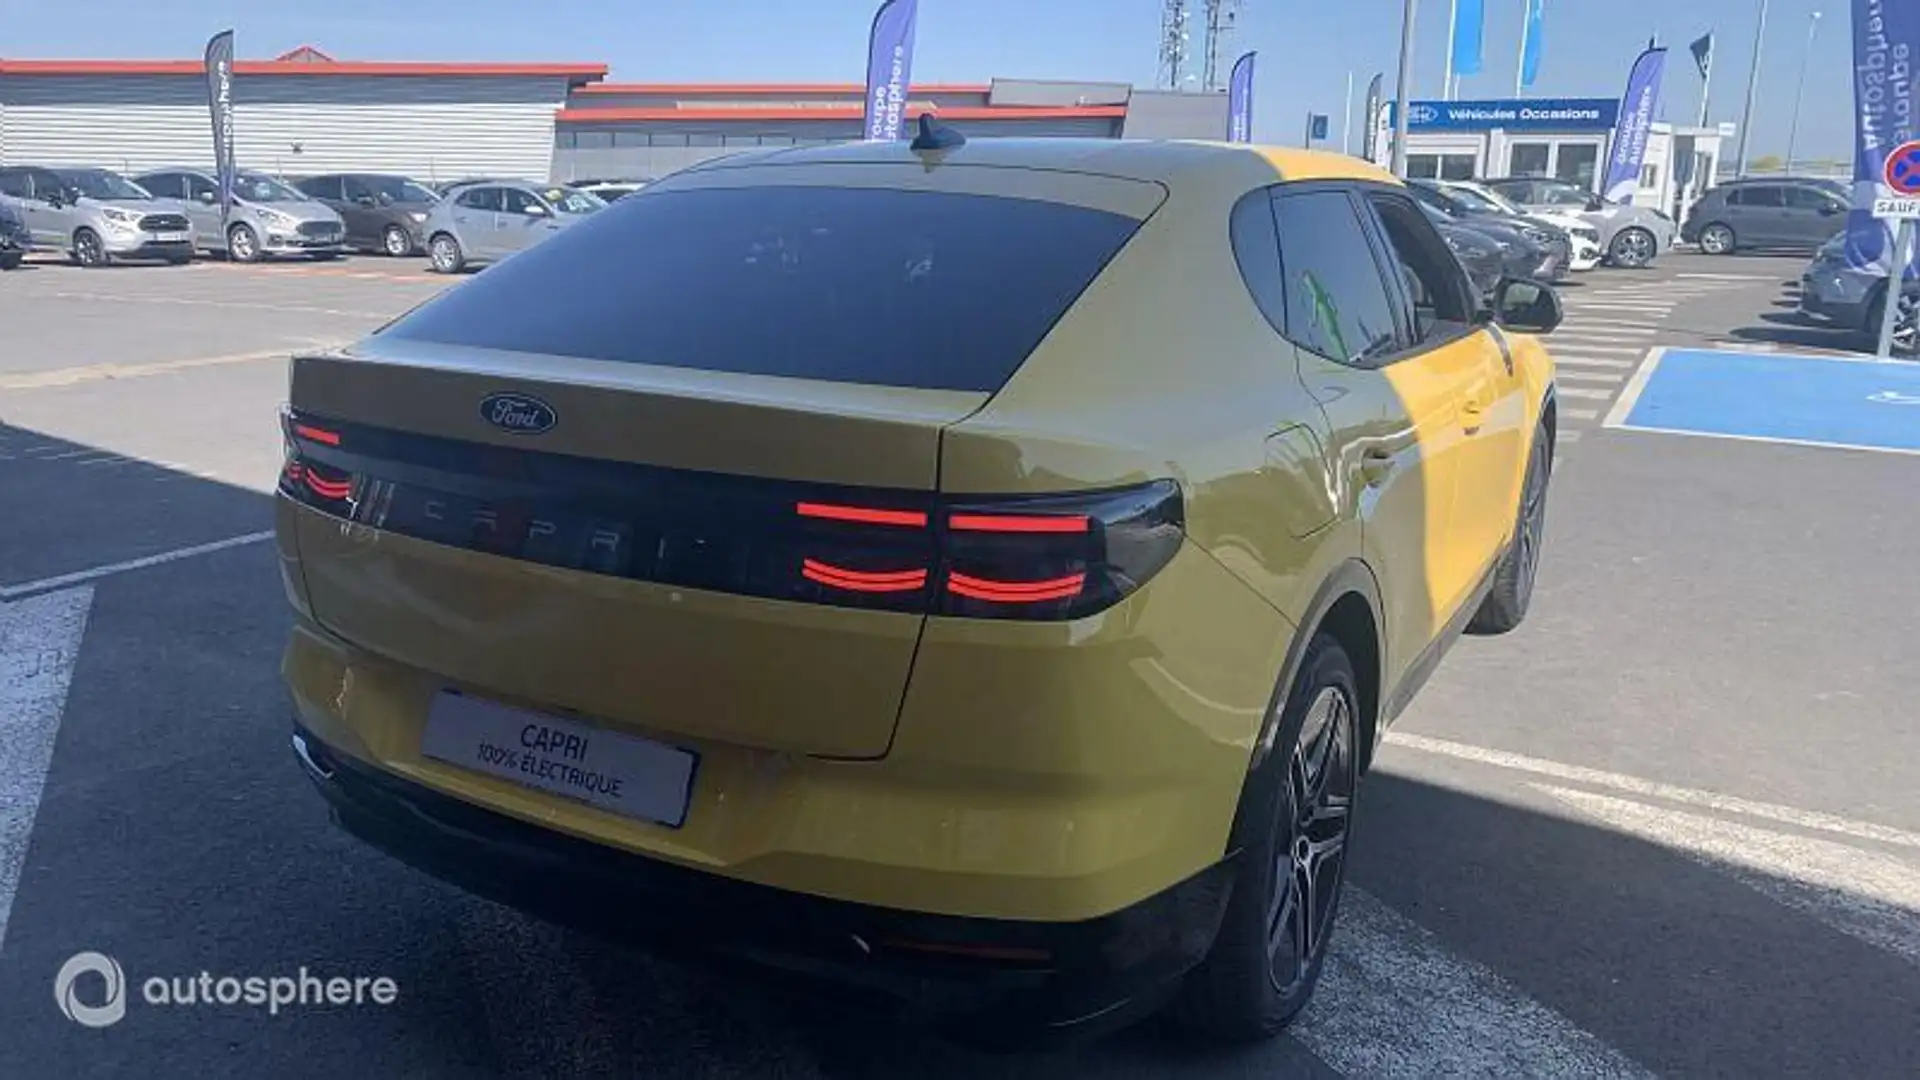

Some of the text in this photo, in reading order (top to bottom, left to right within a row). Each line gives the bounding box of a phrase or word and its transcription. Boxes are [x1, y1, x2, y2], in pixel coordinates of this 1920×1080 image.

[1447, 107, 1516, 120] Véhicules
[1519, 107, 1600, 120] Occasions
[1876, 202, 1917, 212] SAUF
[492, 398, 539, 428] Ford
[520, 724, 589, 763] CAPRI
[478, 742, 519, 768] 100%
[520, 750, 625, 798] ÉLECTRIQUE
